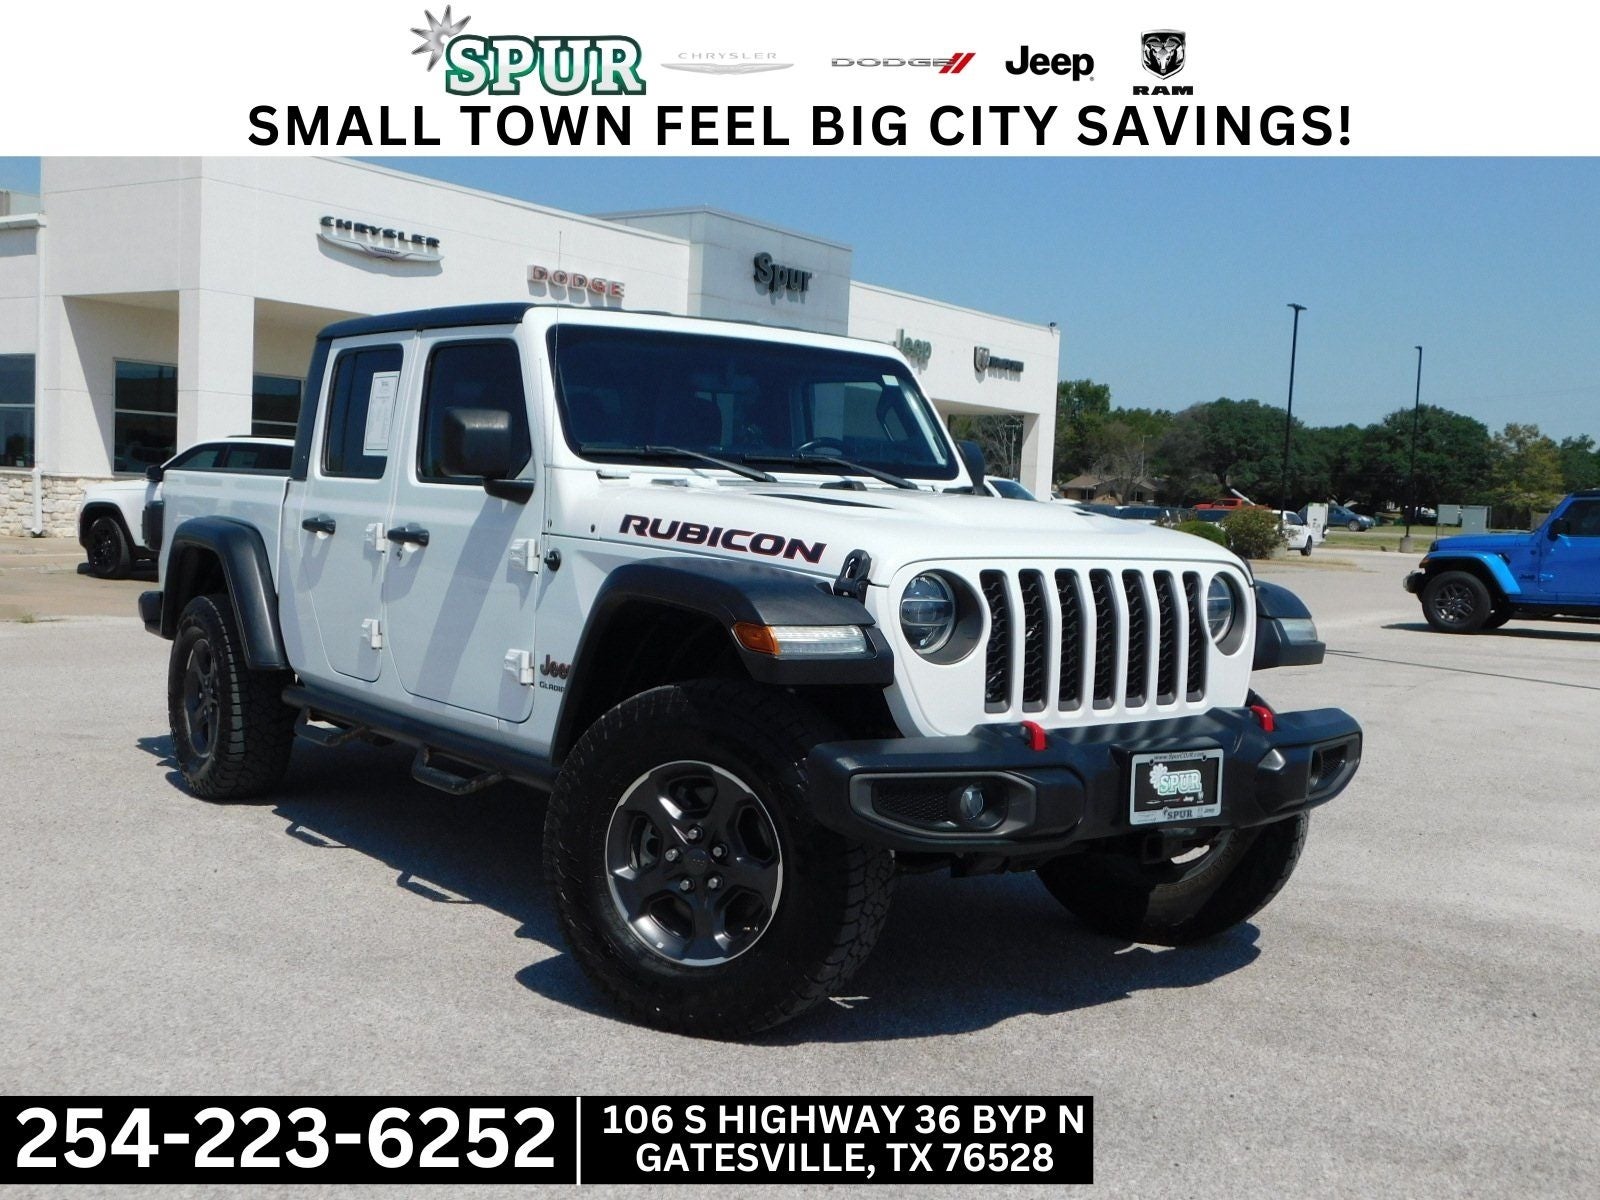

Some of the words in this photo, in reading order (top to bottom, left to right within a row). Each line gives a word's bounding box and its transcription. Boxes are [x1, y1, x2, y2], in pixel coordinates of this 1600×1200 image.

[319, 215, 440, 248] CHRYSLER
[528, 265, 625, 298] DODGE
[753, 252, 812, 292] Spur
[619, 514, 827, 564] RUBICON
[1159, 772, 1201, 793] SPUR
[1167, 809, 1193, 820] SPUR
